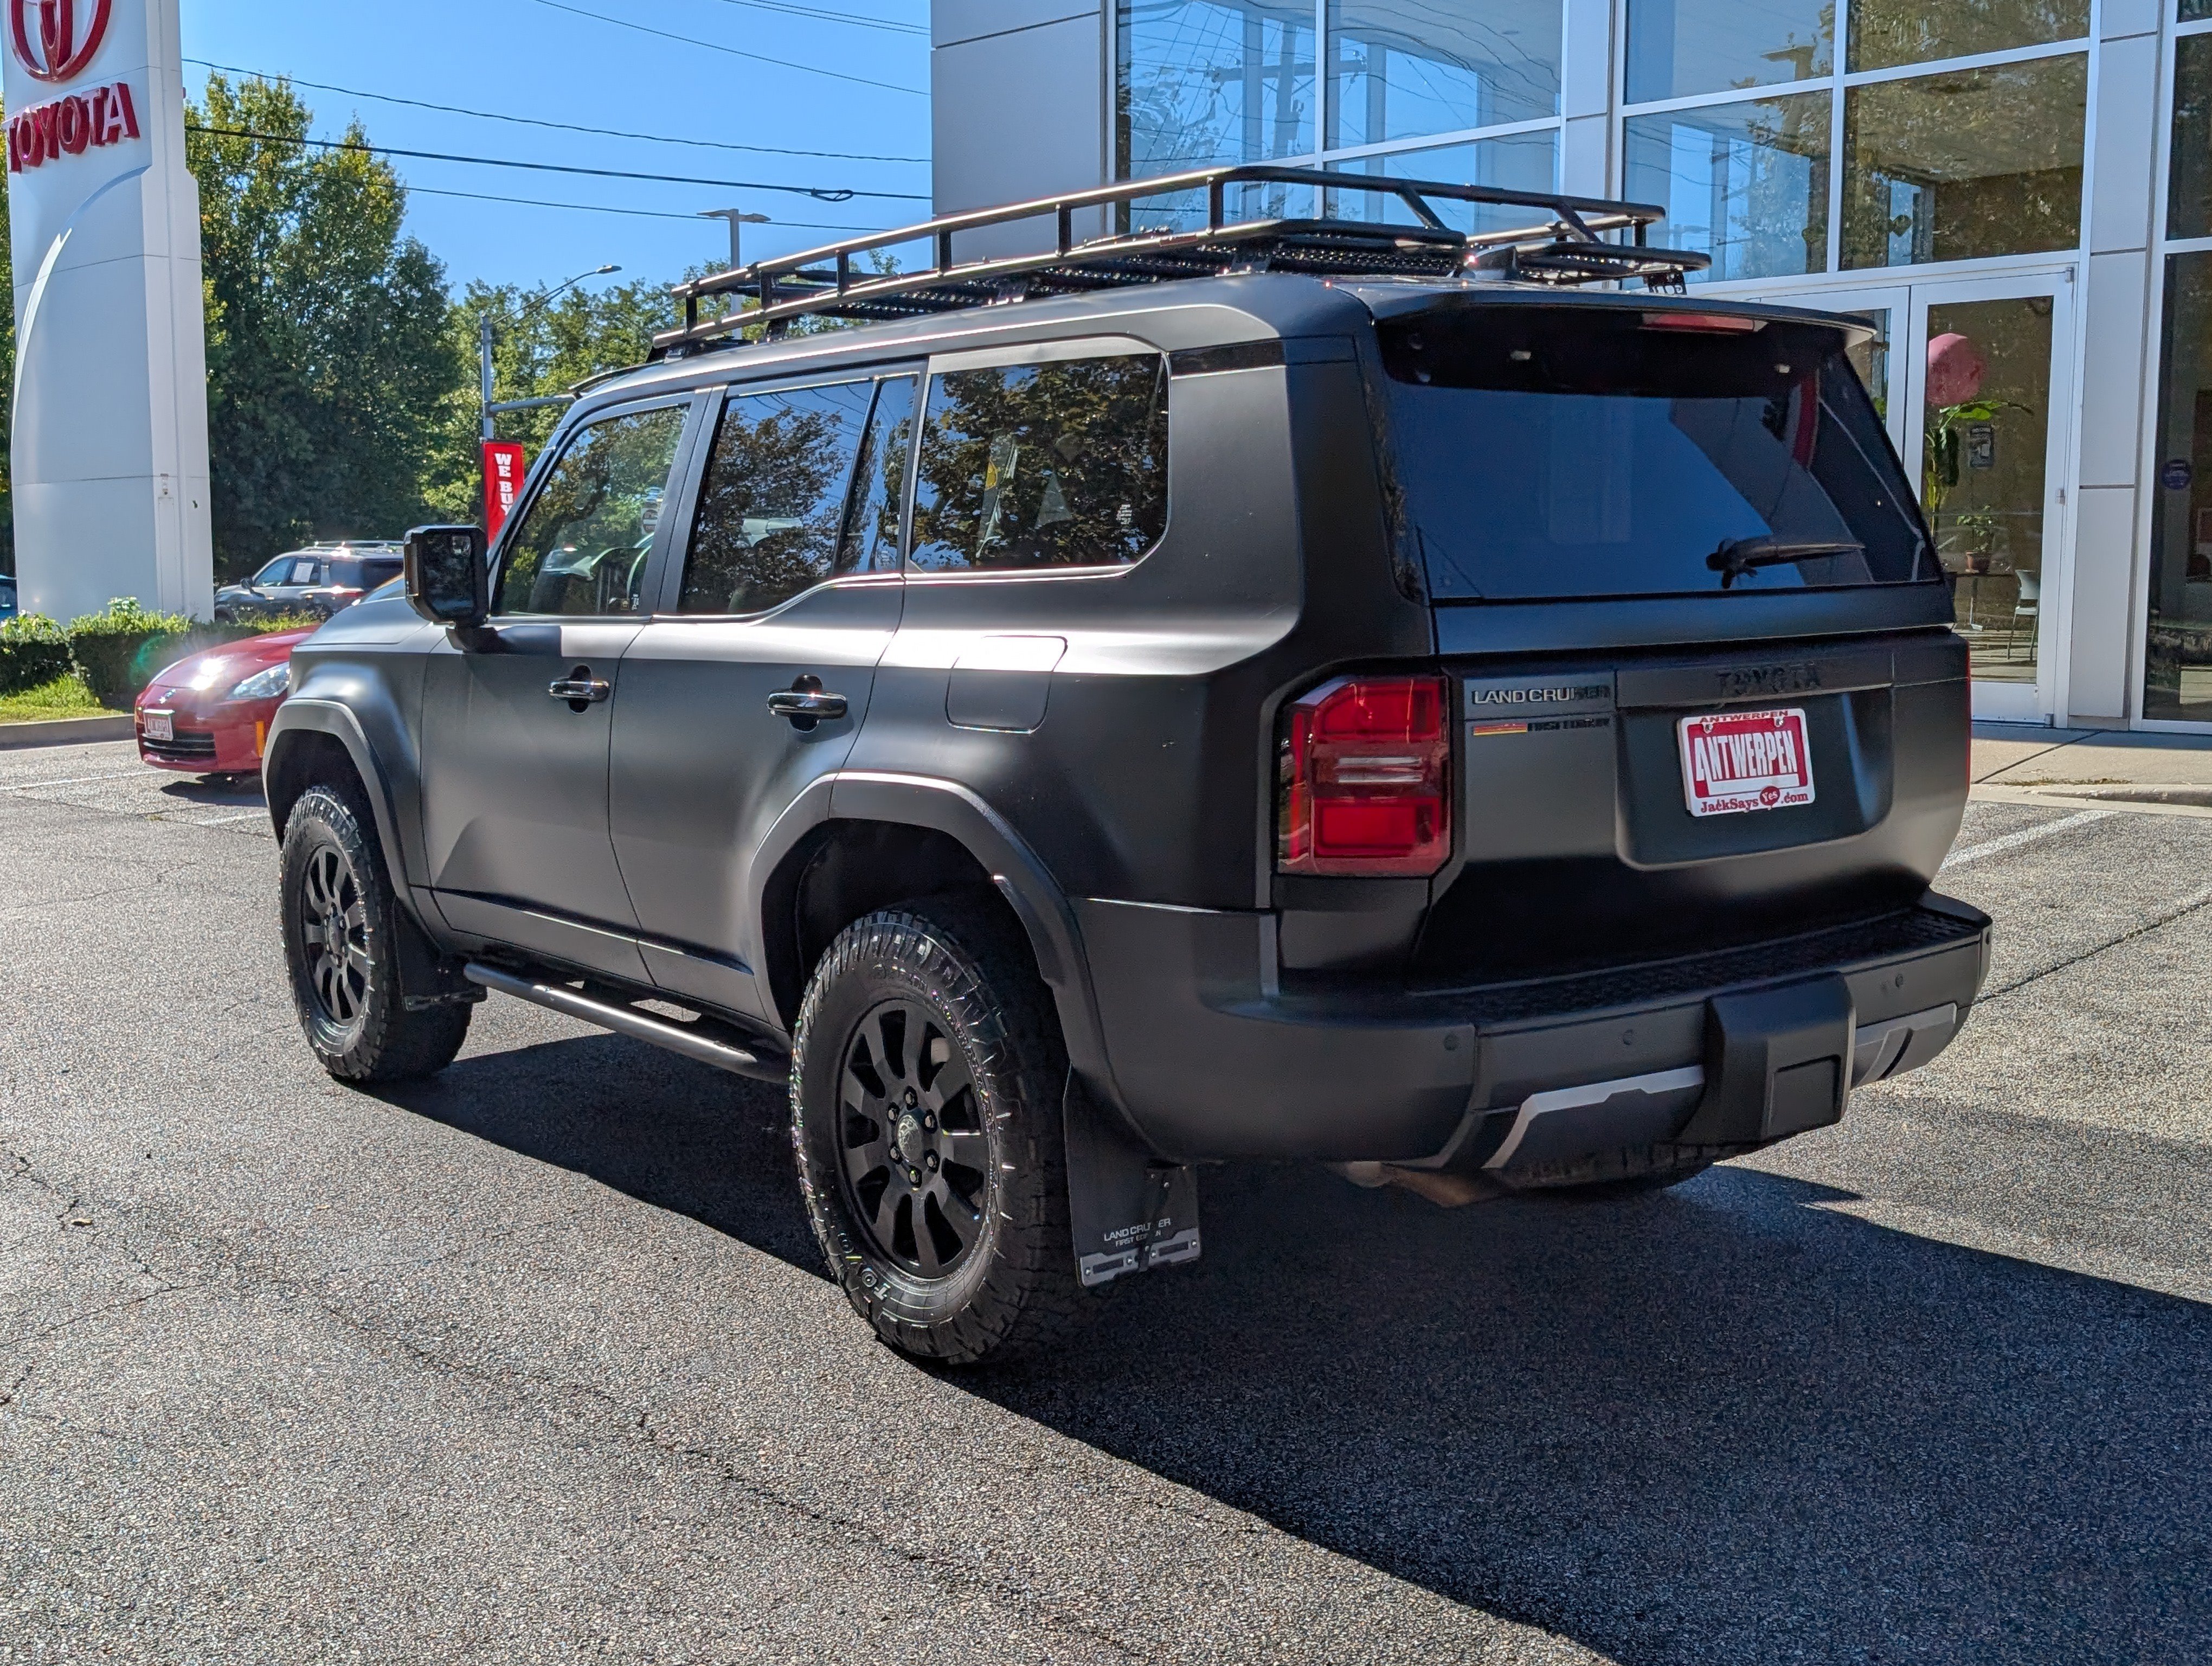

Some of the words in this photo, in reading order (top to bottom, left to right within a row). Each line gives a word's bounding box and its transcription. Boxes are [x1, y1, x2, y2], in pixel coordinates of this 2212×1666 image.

[3, 82, 140, 174] TOYOTA
[494, 453, 512, 478] WE
[499, 480, 514, 516] BUY
[1472, 689, 1526, 704] LAND
[1699, 710, 1789, 723] ANTWERPEN
[1694, 729, 1798, 782] ANTWERPEN
[1700, 798, 1759, 813] JackSays
[1761, 791, 1778, 803] Yes
[1780, 792, 1809, 804] .com
[1104, 1228, 1129, 1241] LAND
[1130, 1218, 1171, 1235] CRUER
[1115, 1236, 1134, 1247] FIRST
